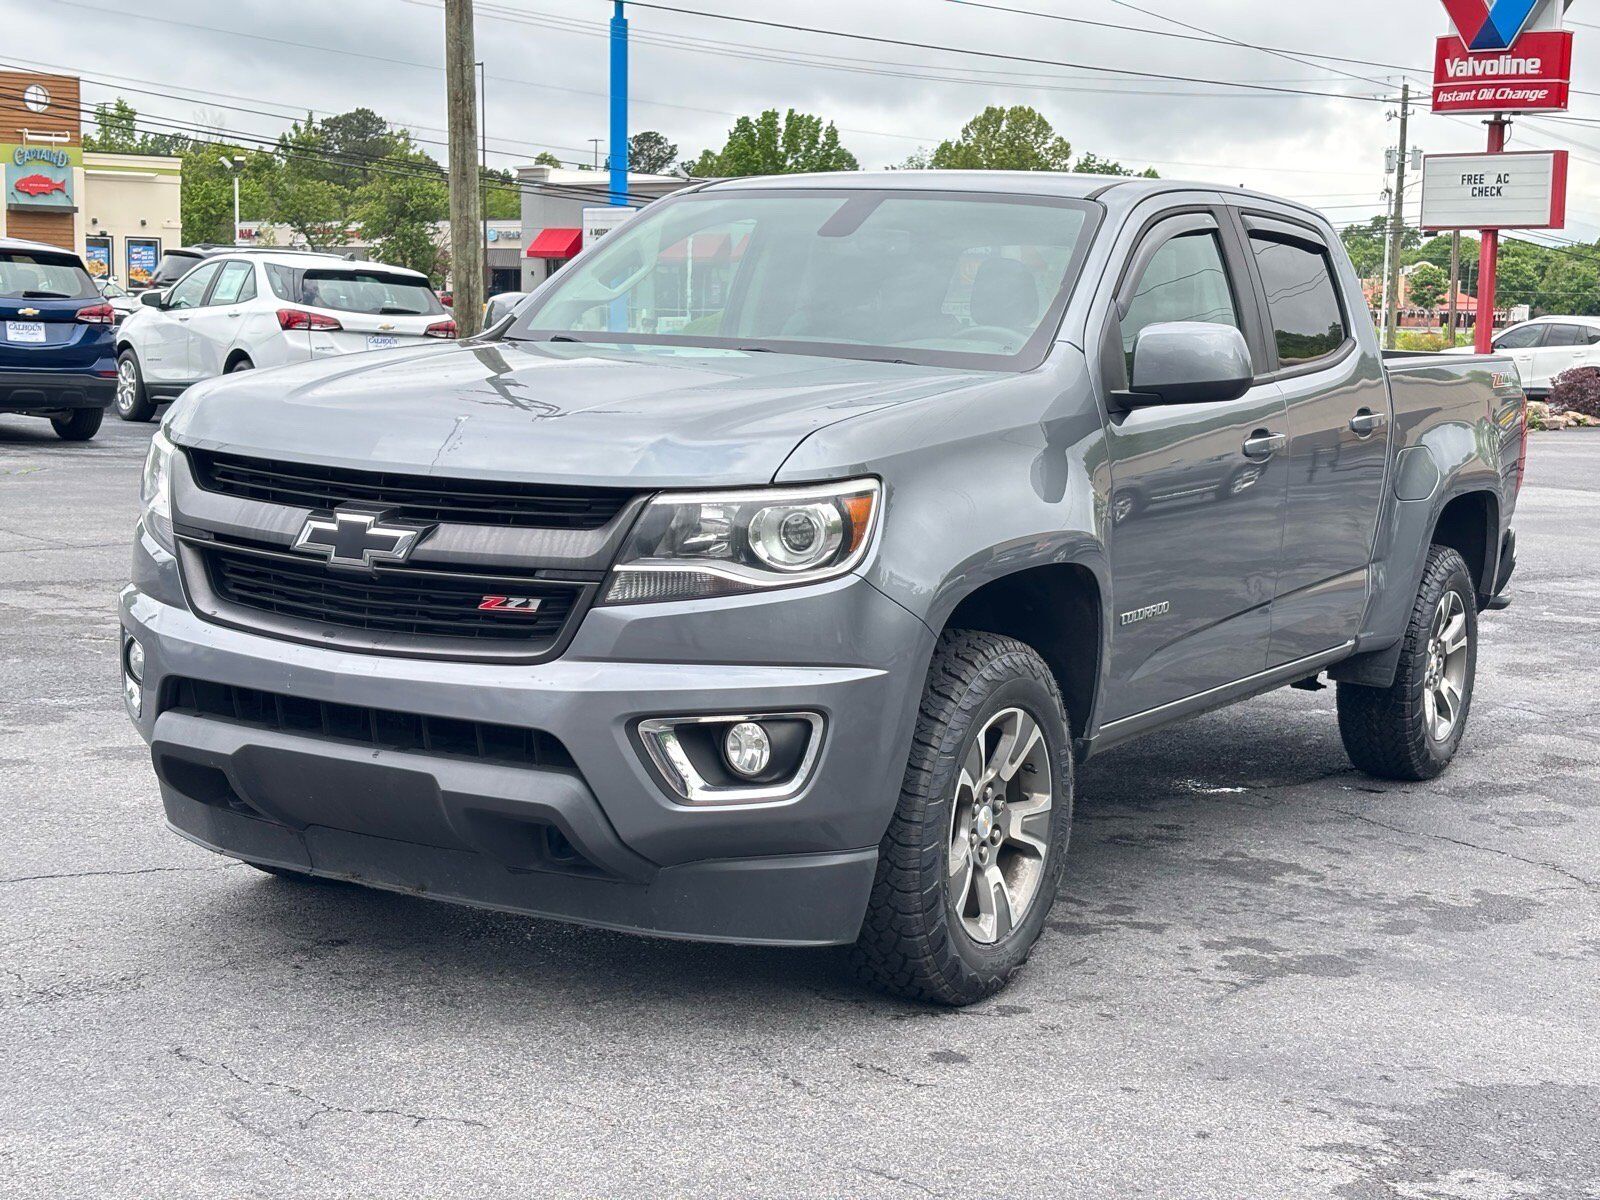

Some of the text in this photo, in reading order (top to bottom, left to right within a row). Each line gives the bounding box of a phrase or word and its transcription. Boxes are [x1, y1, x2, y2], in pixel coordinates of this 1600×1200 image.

[1444, 55, 1541, 78] Valvoline
[1437, 88, 1476, 102] Instant
[1496, 87, 1548, 102] Change
[1461, 173, 1510, 185] FREE AC
[1471, 186, 1503, 197] CHECK
[9, 322, 42, 332] CALHOUN
[368, 336, 399, 345] CALHOUN
[1491, 371, 1513, 388] Z71
[478, 595, 542, 613] Z71
[1120, 600, 1170, 626] COLORADO
